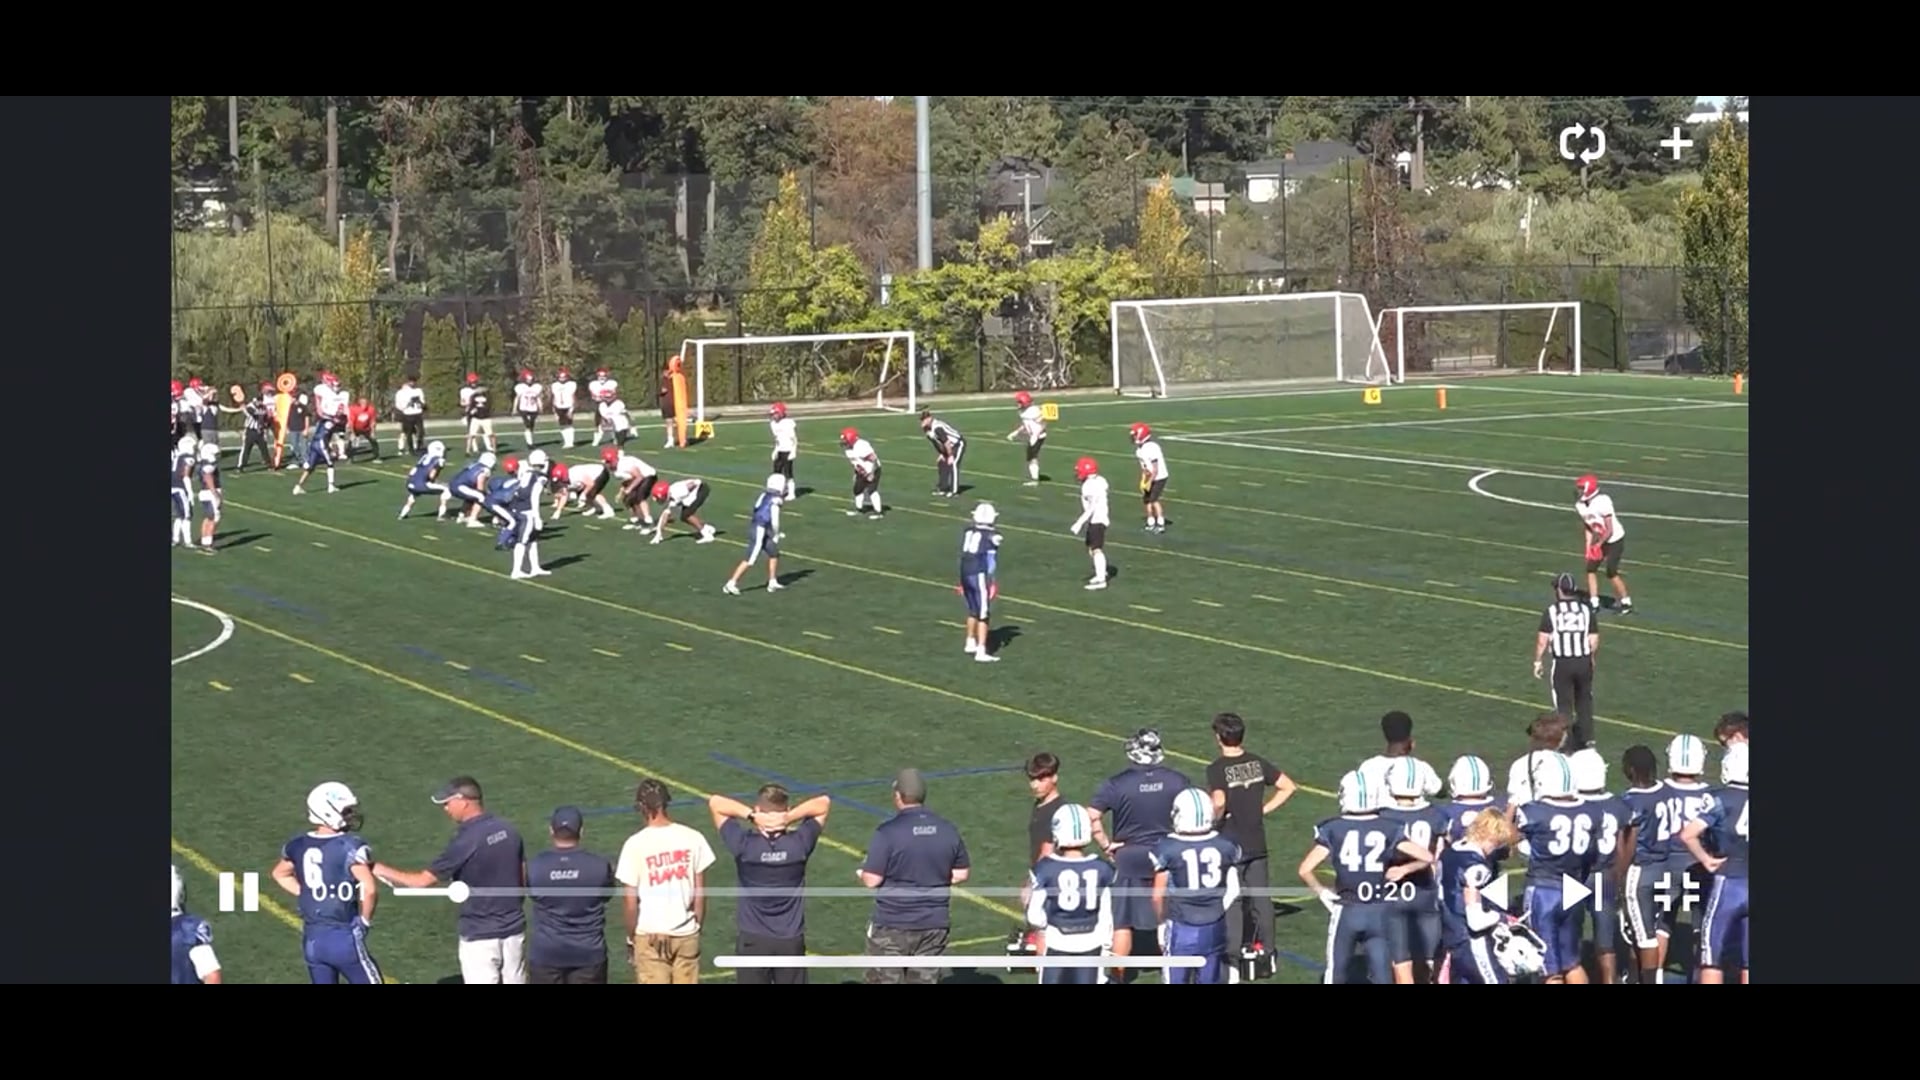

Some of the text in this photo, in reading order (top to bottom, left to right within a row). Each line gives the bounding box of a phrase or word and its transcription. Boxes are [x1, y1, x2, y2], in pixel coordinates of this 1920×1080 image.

[1557, 612, 1586, 633] 121
[1139, 782, 1164, 793] COACH
[1548, 813, 1593, 855] 36
[645, 849, 691, 870] FUTURE
[1339, 830, 1386, 873] 42
[303, 847, 323, 890] 6
[550, 869, 580, 881] COACH
[648, 864, 690, 887] HAWK
[1181, 847, 1222, 891] 13
[1057, 869, 1099, 912] 81
